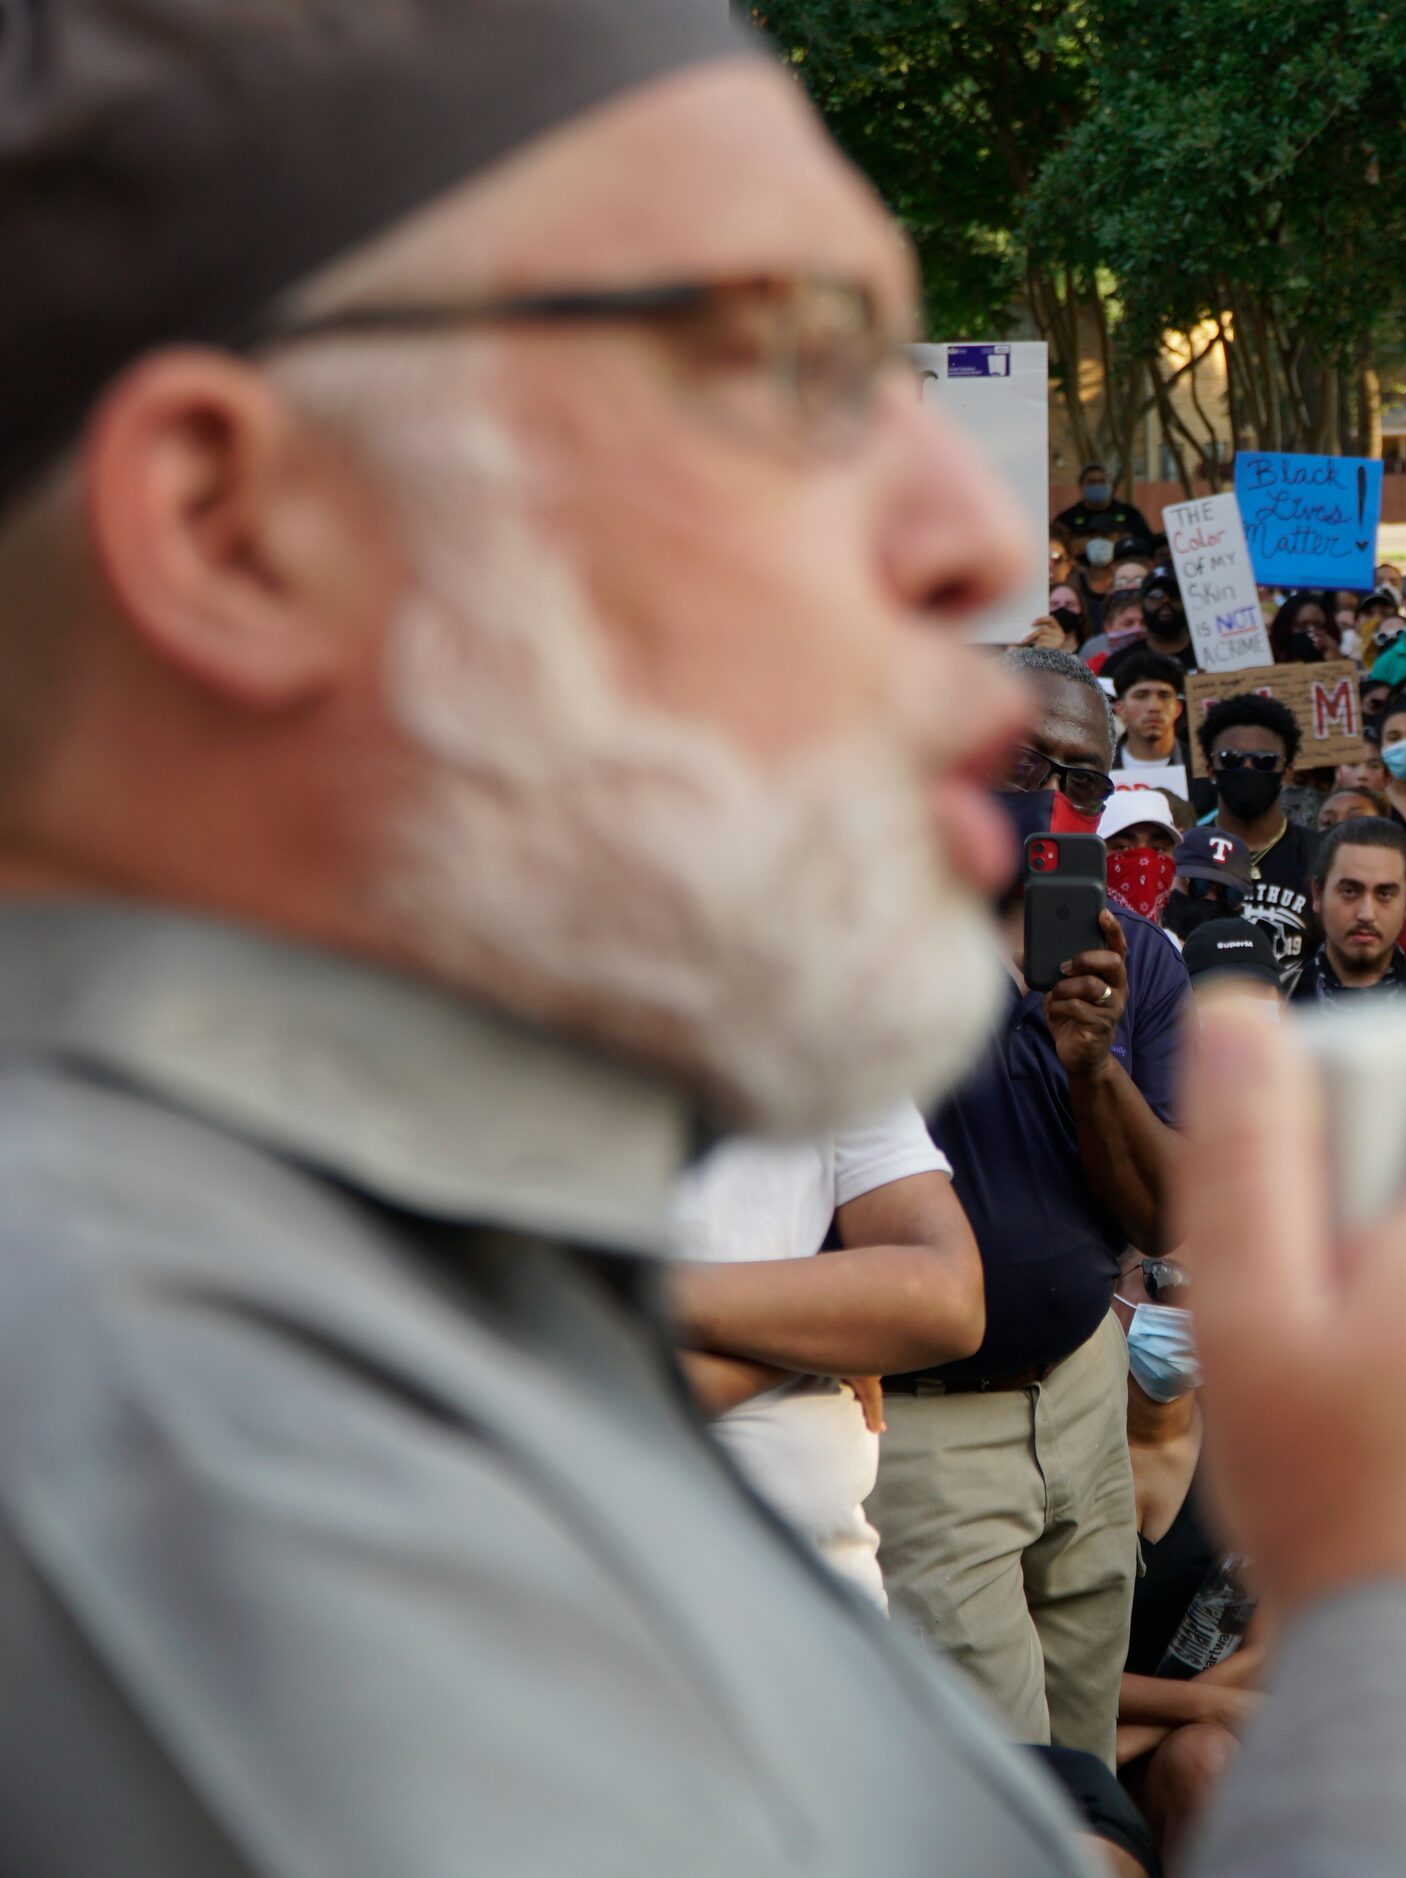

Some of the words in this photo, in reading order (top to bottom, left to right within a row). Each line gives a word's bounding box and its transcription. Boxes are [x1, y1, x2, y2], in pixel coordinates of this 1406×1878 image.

[1247, 457, 1347, 491] Black
[1170, 502, 1214, 527] THE
[1255, 489, 1353, 526] Lives
[1173, 528, 1225, 554] Color
[1243, 520, 1353, 560] Matter
[1183, 557, 1205, 578] OF
[1211, 552, 1237, 571] MY
[1215, 605, 1257, 634] NOT
[1209, 837, 1234, 865] T
